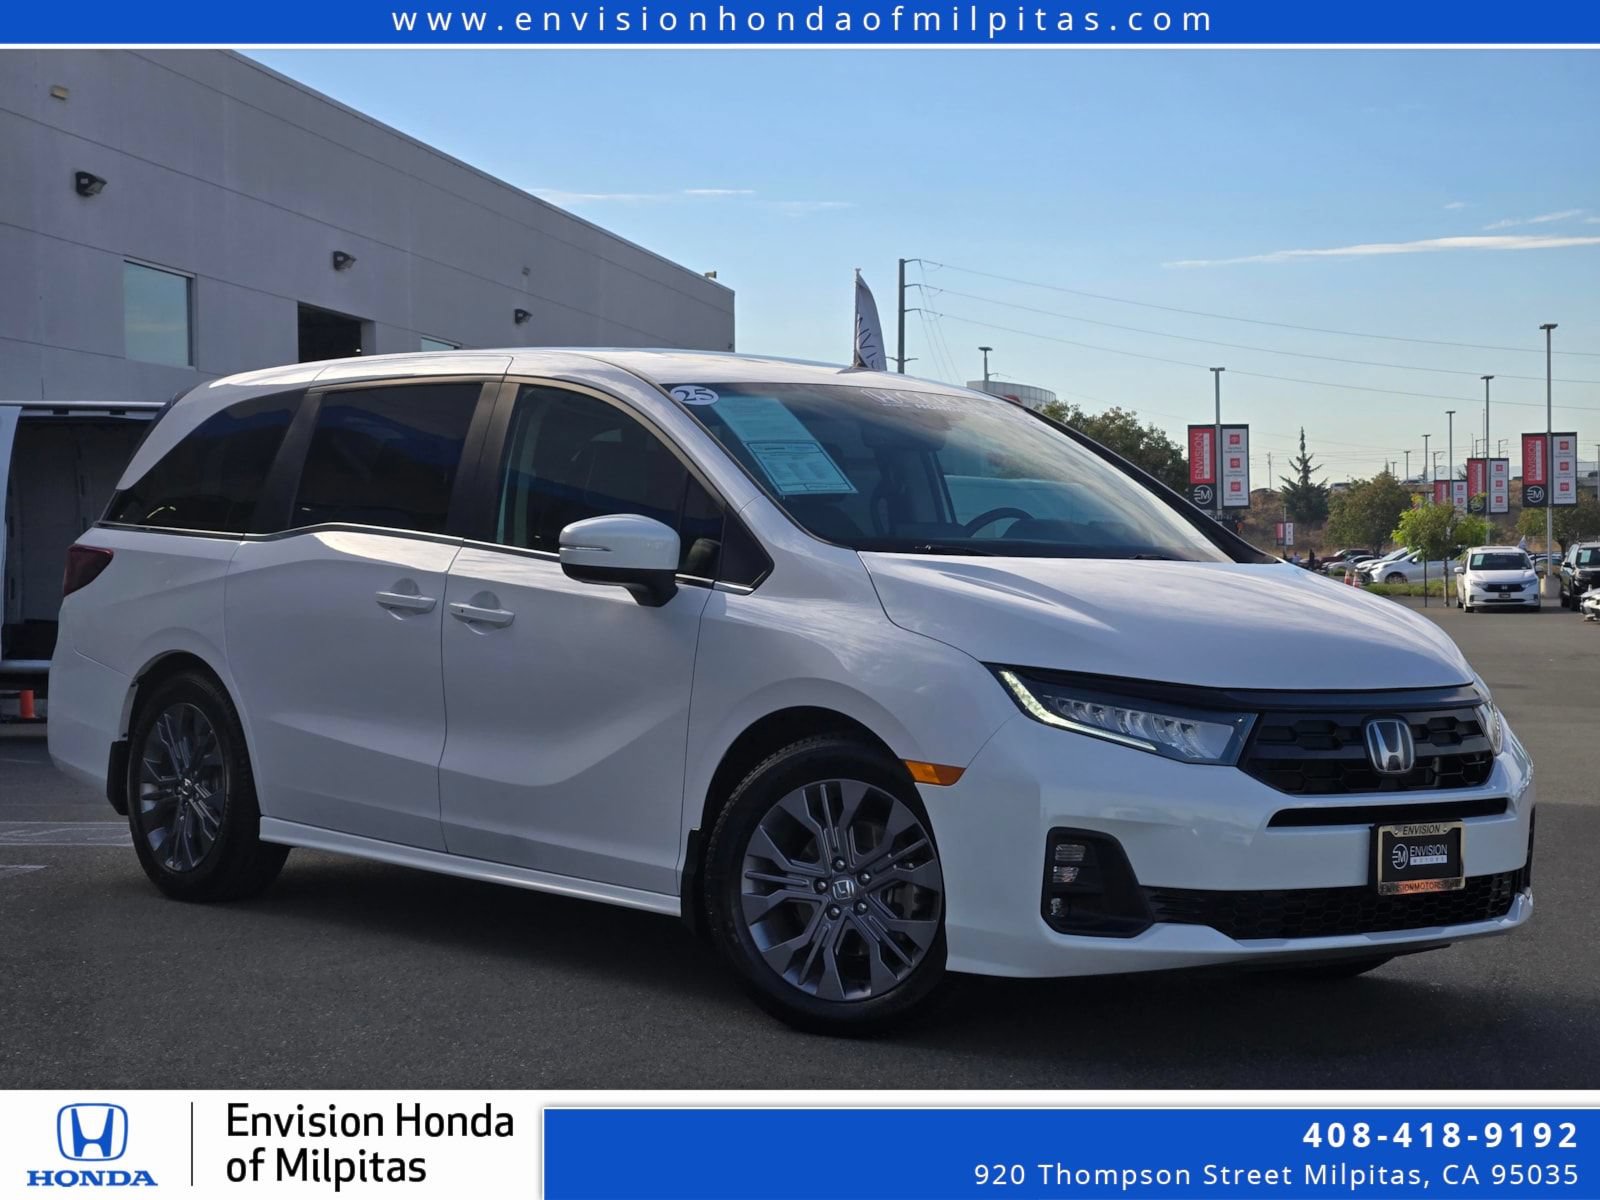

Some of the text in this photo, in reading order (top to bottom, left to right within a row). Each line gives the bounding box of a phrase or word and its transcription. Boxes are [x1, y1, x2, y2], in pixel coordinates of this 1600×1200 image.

[674, 388, 714, 402] 25
[1195, 433, 1203, 480] ENVISION
[1402, 824, 1441, 836] ENVISION
[1409, 844, 1448, 857] ENVISION
